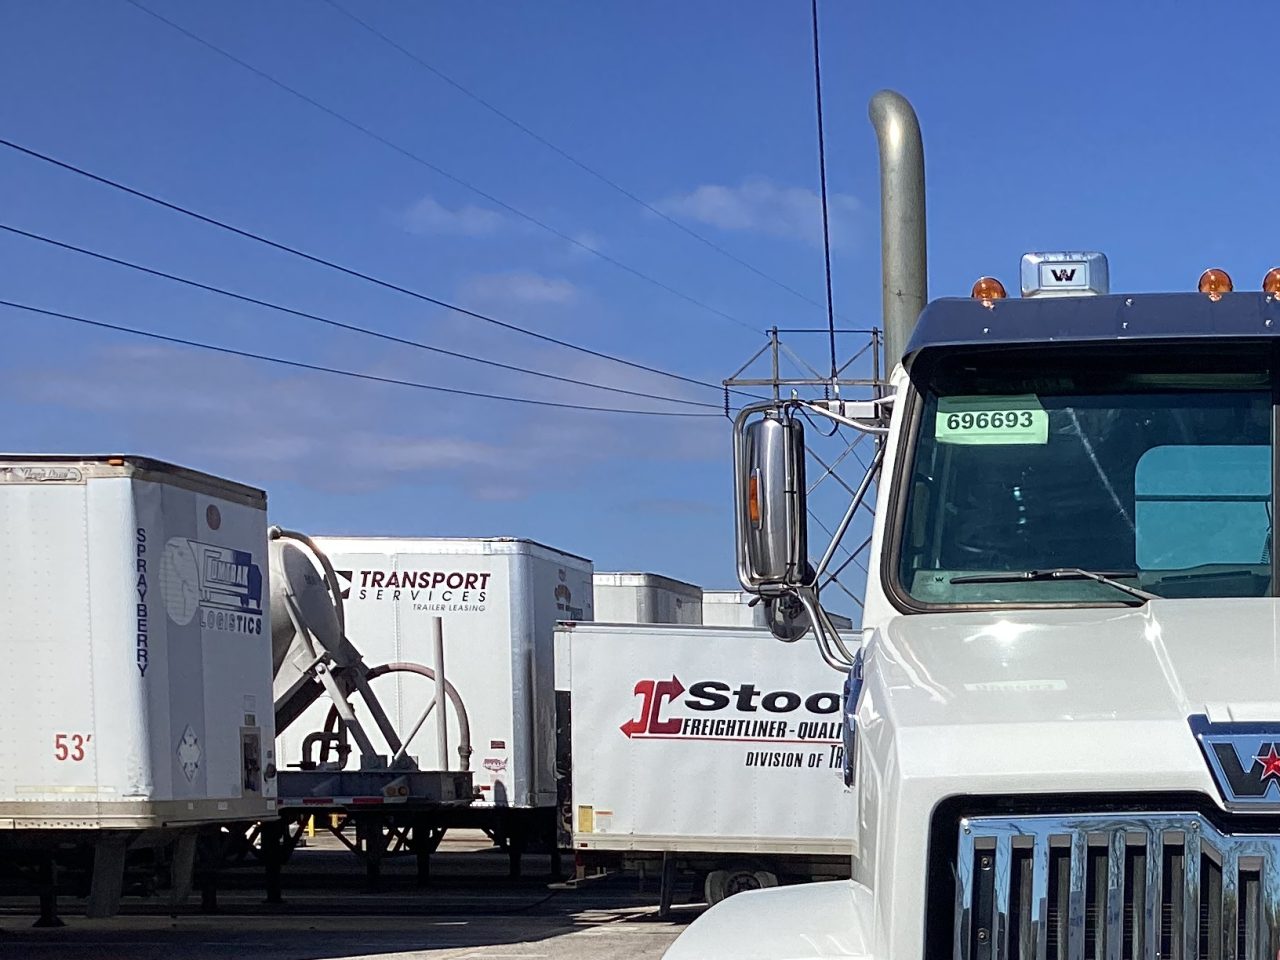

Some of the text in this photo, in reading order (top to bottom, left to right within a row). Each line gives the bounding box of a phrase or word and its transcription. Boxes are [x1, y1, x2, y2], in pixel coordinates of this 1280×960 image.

[946, 410, 1034, 430] 696693
[359, 570, 491, 590] TRANSPORT
[136, 527, 149, 678] SPRAYBERRY
[359, 589, 487, 603] SERVICES
[412, 603, 486, 612] TRAILER LEASING
[200, 608, 262, 635] LOGISTICS
[684, 680, 841, 715] Stoo
[682, 717, 787, 738] FREIGHTLINER
[54, 733, 92, 762] 53'
[745, 744, 843, 769] DIVISION OF TR
